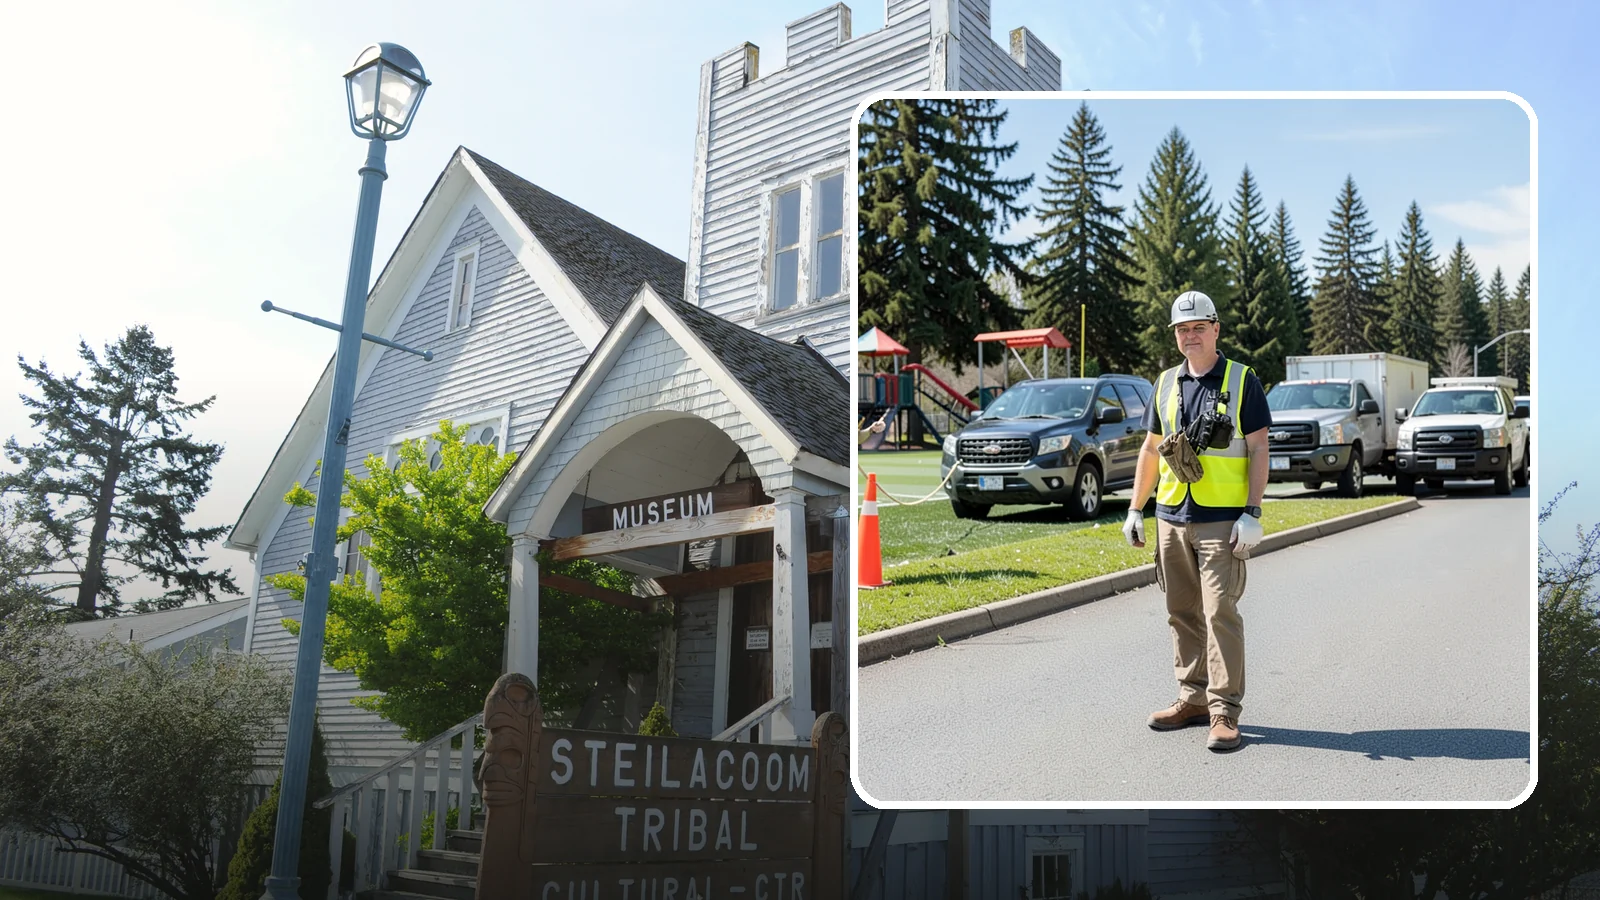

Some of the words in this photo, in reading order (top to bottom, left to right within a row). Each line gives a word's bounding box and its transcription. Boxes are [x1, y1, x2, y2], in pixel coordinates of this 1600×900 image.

[612, 491, 714, 531] MUSEUM
[550, 738, 809, 793] STEILACOOM
[614, 806, 758, 852] TRIBAL
